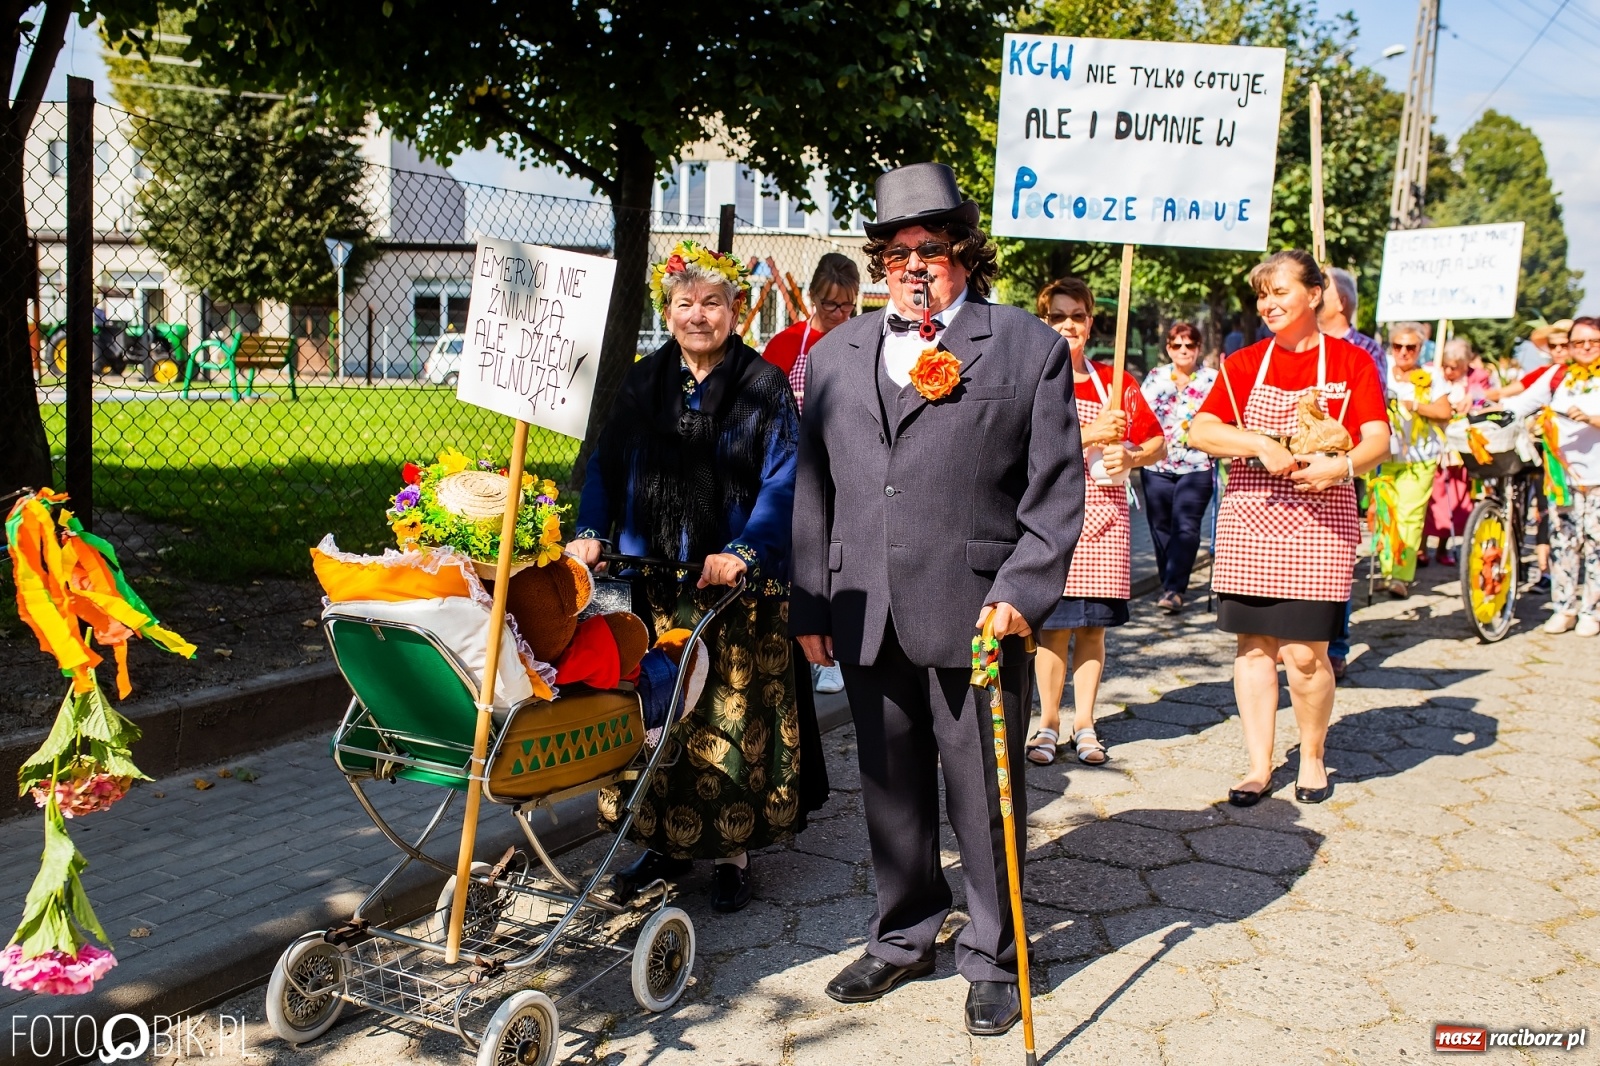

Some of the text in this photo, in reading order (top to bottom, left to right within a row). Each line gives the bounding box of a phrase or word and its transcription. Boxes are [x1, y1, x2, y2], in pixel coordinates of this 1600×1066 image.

[1009, 39, 1074, 81] KGW
[1086, 64, 1117, 84] NIE
[1130, 66, 1185, 89] TYLKO
[1025, 107, 1236, 147] ALE I DUMNIE W
[480, 246, 586, 298] EMERYCI NIE
[474, 318, 575, 373] ALE DZIECI
